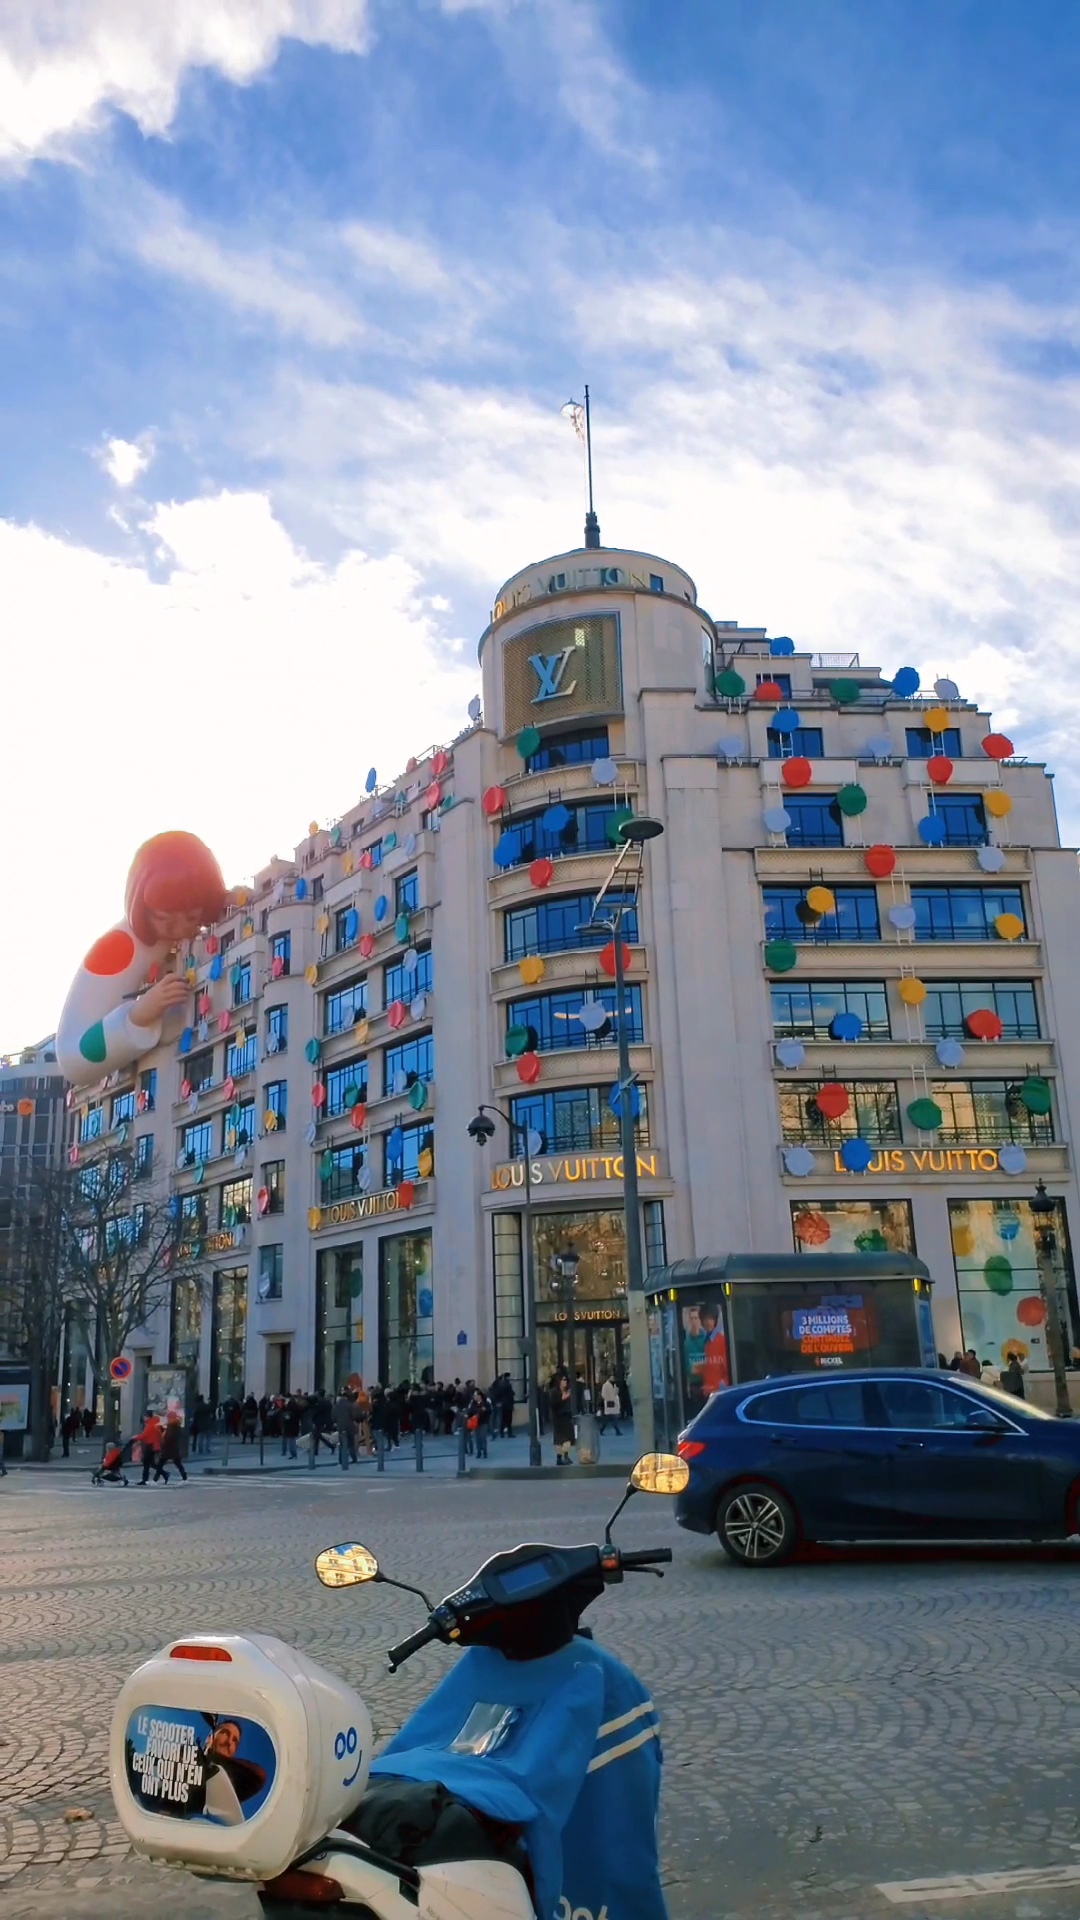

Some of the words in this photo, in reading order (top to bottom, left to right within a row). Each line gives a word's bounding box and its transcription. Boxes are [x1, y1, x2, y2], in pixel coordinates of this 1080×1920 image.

[834, 1150, 907, 1173] LUIS
[910, 1149, 999, 1171] VUITTO
[490, 1162, 544, 1191] LOUS
[554, 1311, 580, 1321] LOS
[799, 1326, 811, 1334] DE
[812, 1324, 852, 1334] COMPTES
[801, 1316, 807, 1325] 3
[808, 1315, 849, 1325] MILLIONS
[137, 1715, 149, 1736] LE
[149, 1718, 195, 1745] SCOOTER
[146, 1737, 181, 1763] FAVORI
[182, 1744, 199, 1766] DE
[132, 1752, 155, 1775] CEUX
[157, 1758, 175, 1780] QUI
[176, 1762, 203, 1786] N'EN
[141, 1773, 160, 1797] ONT
[161, 1779, 190, 1804] PLUS
